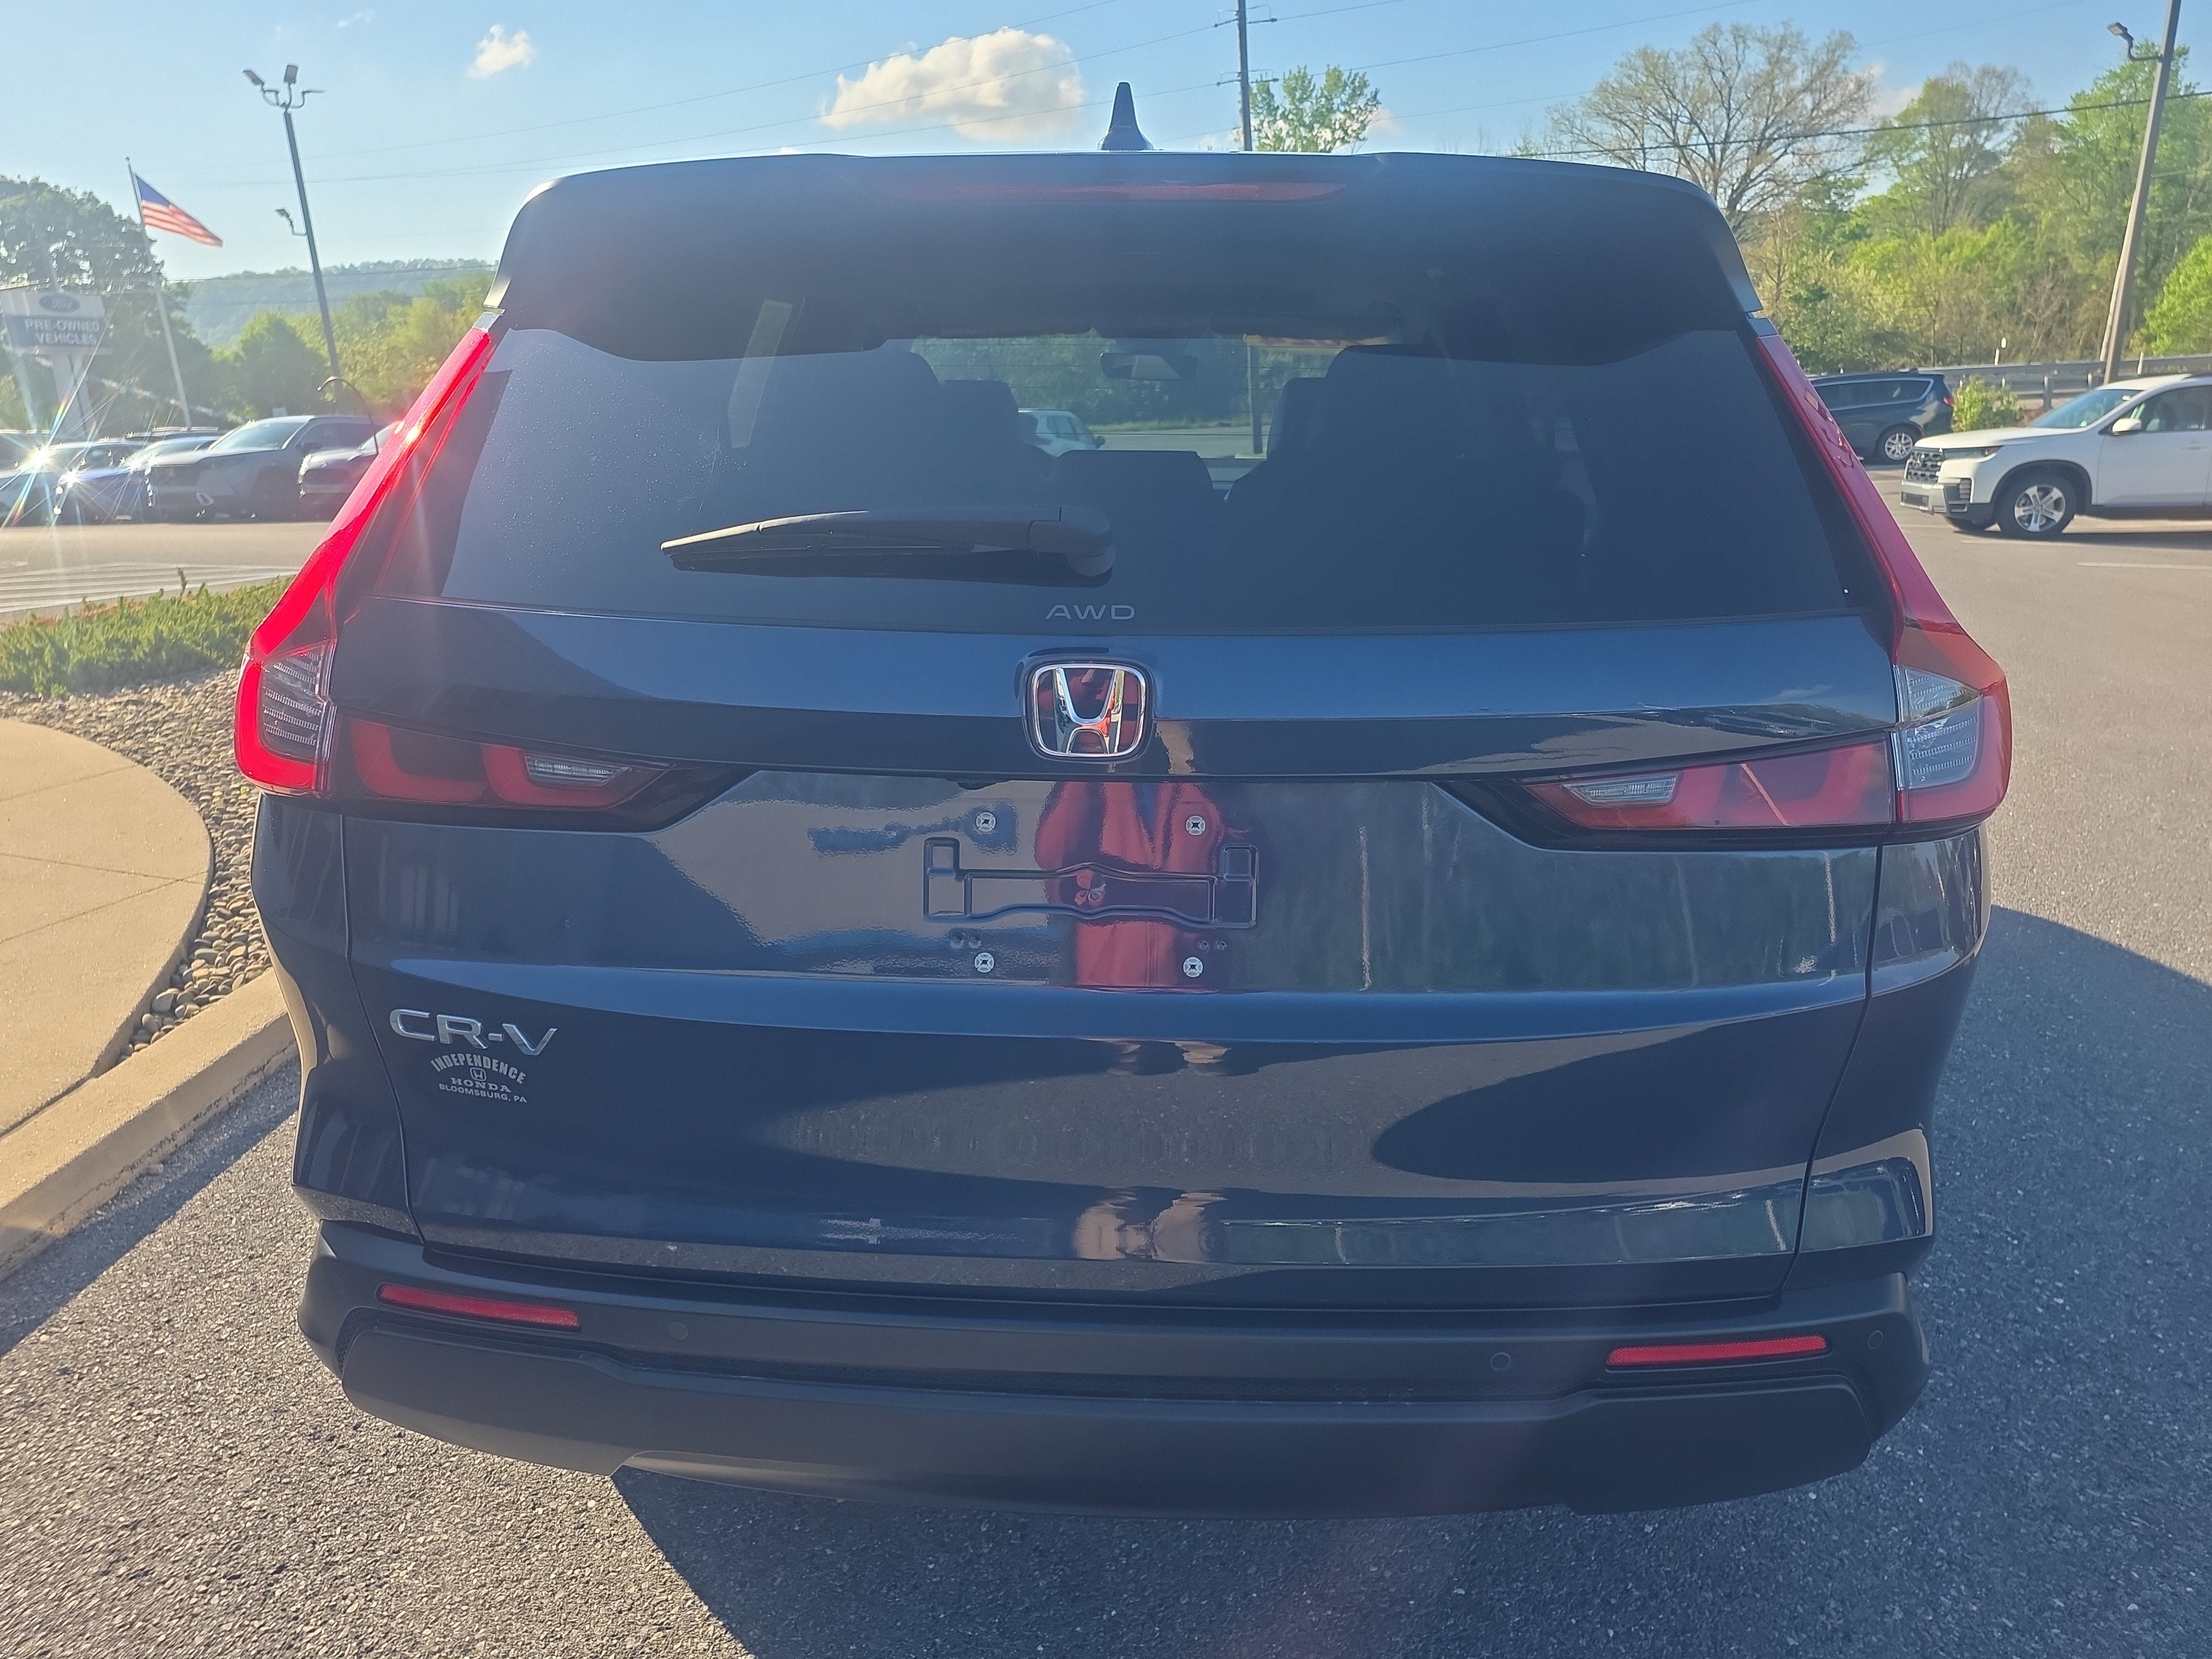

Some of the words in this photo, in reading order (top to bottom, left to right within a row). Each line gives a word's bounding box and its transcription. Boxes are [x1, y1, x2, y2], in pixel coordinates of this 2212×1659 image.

[25, 318, 100, 332] PRE-OWNED
[35, 331, 97, 345] VEHICLES
[1045, 605, 1135, 620] AWD
[389, 1008, 558, 1056] CR-V
[430, 1053, 526, 1084] INDEPENDENCE
[451, 1077, 511, 1092] HONDA
[439, 1083, 512, 1102] BLOOMSBURG,
[513, 1095, 528, 1103] PA
